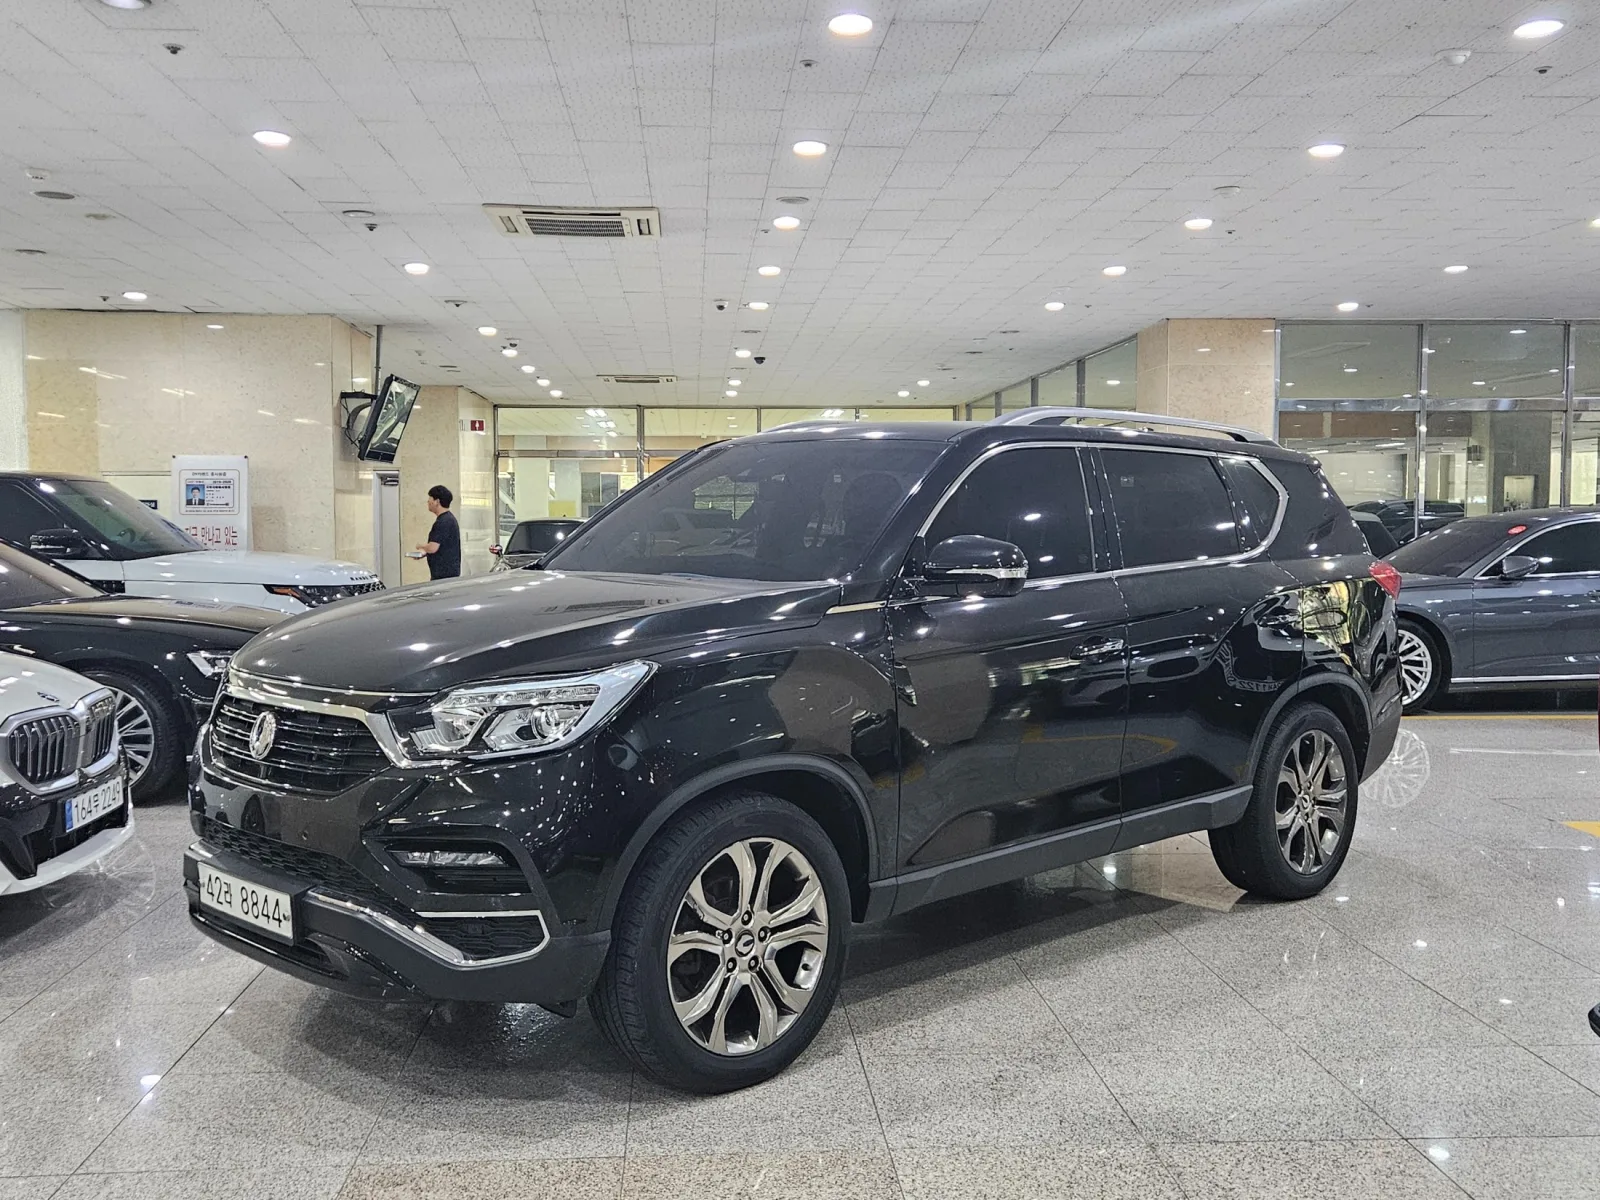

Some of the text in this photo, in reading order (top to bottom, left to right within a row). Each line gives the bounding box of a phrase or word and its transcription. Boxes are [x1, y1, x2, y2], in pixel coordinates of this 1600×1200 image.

[225, 525, 238, 546] 있는
[207, 873, 282, 928] 42라 8844
